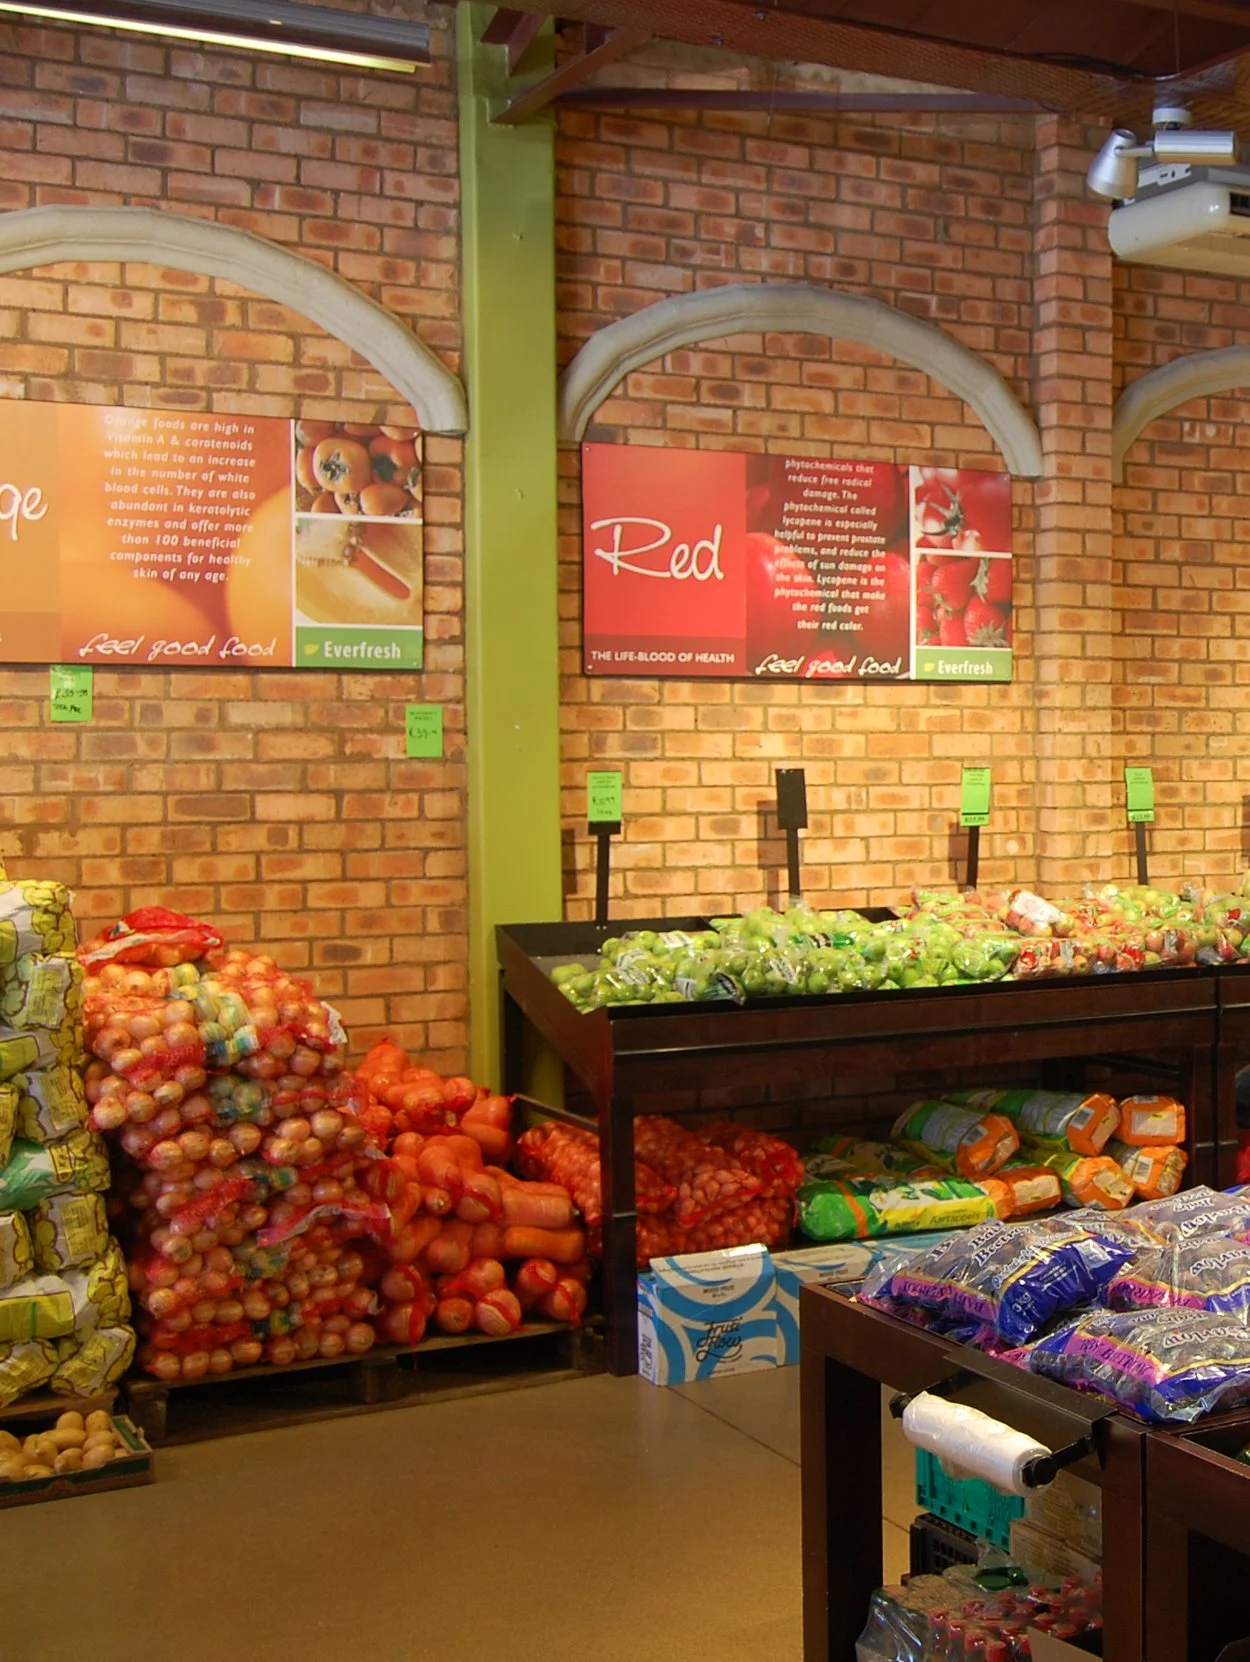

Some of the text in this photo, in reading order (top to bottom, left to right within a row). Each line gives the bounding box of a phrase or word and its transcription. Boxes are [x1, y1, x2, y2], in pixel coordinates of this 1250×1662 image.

[153, 417, 185, 430] foods
[191, 422, 209, 432] are
[214, 422, 239, 435] high
[244, 424, 255, 434] in
[107, 432, 253, 451] Vitamin A & carotenoids
[103, 449, 256, 467] which lead to an increase
[110, 466, 249, 483] in the number of white
[785, 459, 874, 474] phytochemicals that
[787, 474, 873, 487] reduce free radical
[104, 482, 256, 500] blood cells. They are also
[802, 488, 858, 501] damage. The
[111, 500, 250, 518] abundant in keratolytic
[783, 501, 877, 516] phytochemical called
[107, 518, 254, 533] enzymes and offer more
[782, 515, 878, 532] lycopene is especially
[121, 534, 240, 549] than 100 beneficial
[774, 528, 886, 545] helpful to prevent prostate
[590, 516, 724, 582] Red
[820, 546, 838, 556] and
[839, 547, 869, 557] reduce
[871, 548, 886, 558] the
[110, 551, 251, 568] components for healthy
[807, 559, 820, 571] of
[820, 561, 836, 570] sun
[838, 561, 873, 573] damage
[874, 564, 886, 572] on
[133, 567, 229, 584] skin of any age.
[775, 573, 791, 582] the
[816, 574, 858, 586] Lycopene
[860, 576, 868, 585] is
[870, 577, 886, 586] the
[774, 587, 886, 600] phytochemical that make
[792, 602, 869, 616] the red foods get
[797, 620, 820, 630] their
[822, 620, 838, 630] red
[79, 632, 401, 662] feel good food Everfresh
[591, 650, 735, 664] THE LIFE-BLOOD OF HEALTH
[755, 654, 993, 678] feel good food Everfresh
